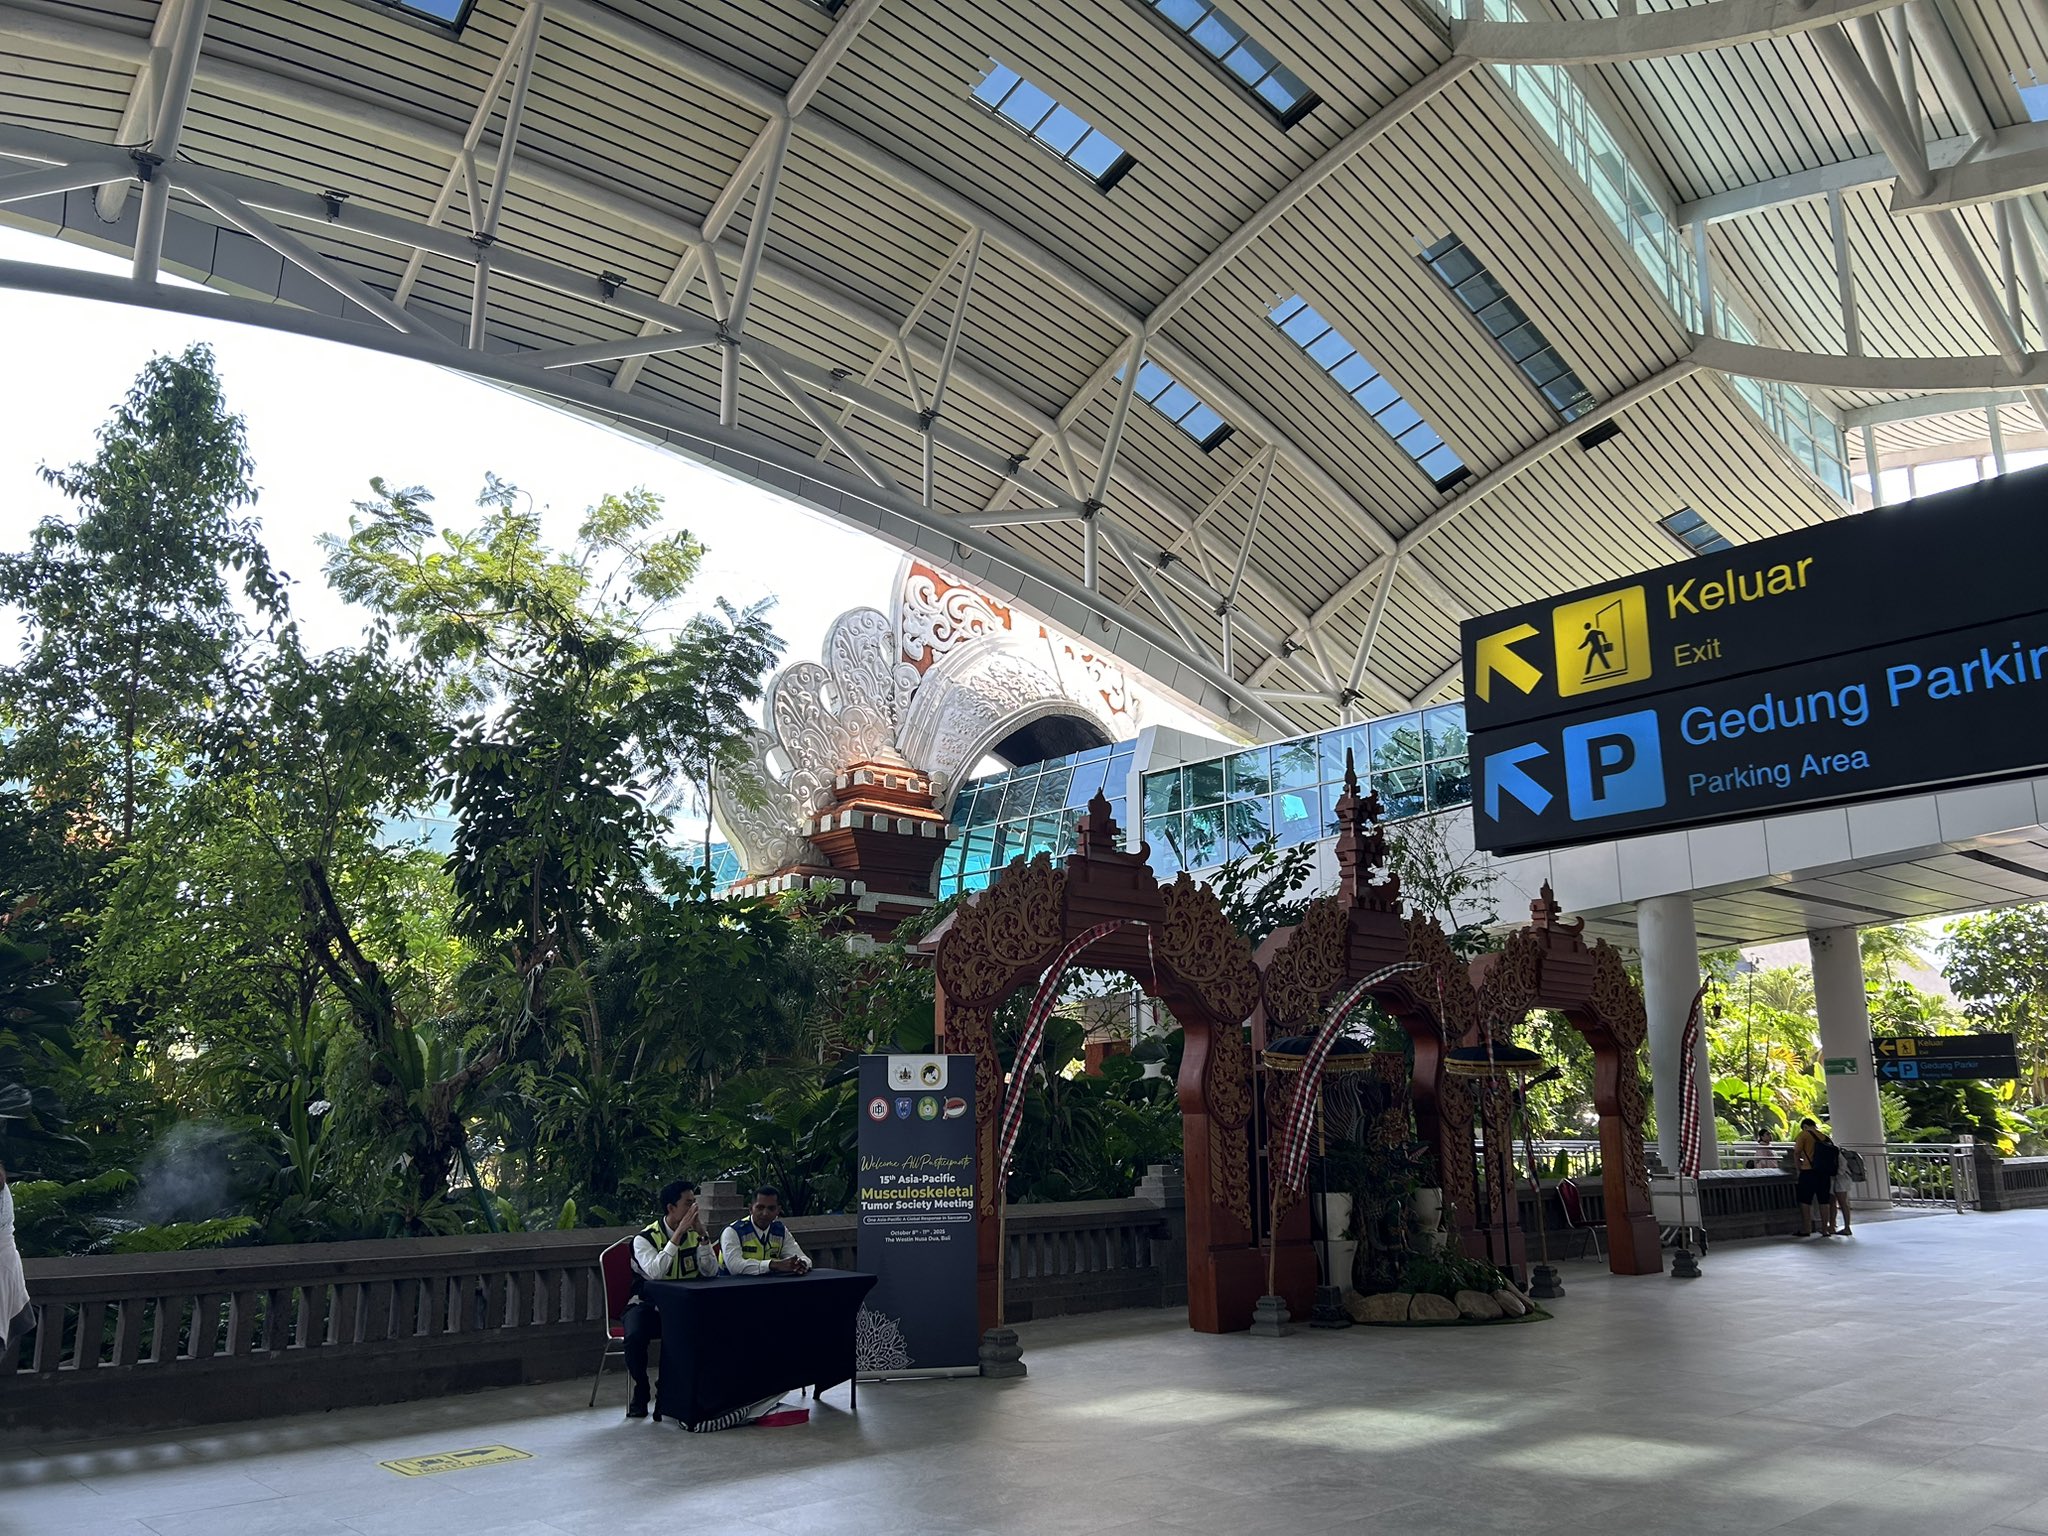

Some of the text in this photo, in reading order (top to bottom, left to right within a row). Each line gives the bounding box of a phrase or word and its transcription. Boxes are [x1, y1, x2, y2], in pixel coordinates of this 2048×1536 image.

[1667, 557, 1814, 619] Keluar
[1675, 638, 1722, 667] Exit
[1681, 684, 1869, 746] Gedung
[1588, 733, 1635, 801] P
[1689, 749, 1869, 796] Parking Area
[1904, 1064, 1913, 1075] P
[1920, 1062, 1953, 1070] Gedung
[861, 1155, 899, 1171] Welcome
[879, 1173, 956, 1184] 15th Asia-Pacific
[861, 1185, 973, 1199] Musculoskeletal
[860, 1198, 974, 1210] Tumor Society Meeting
